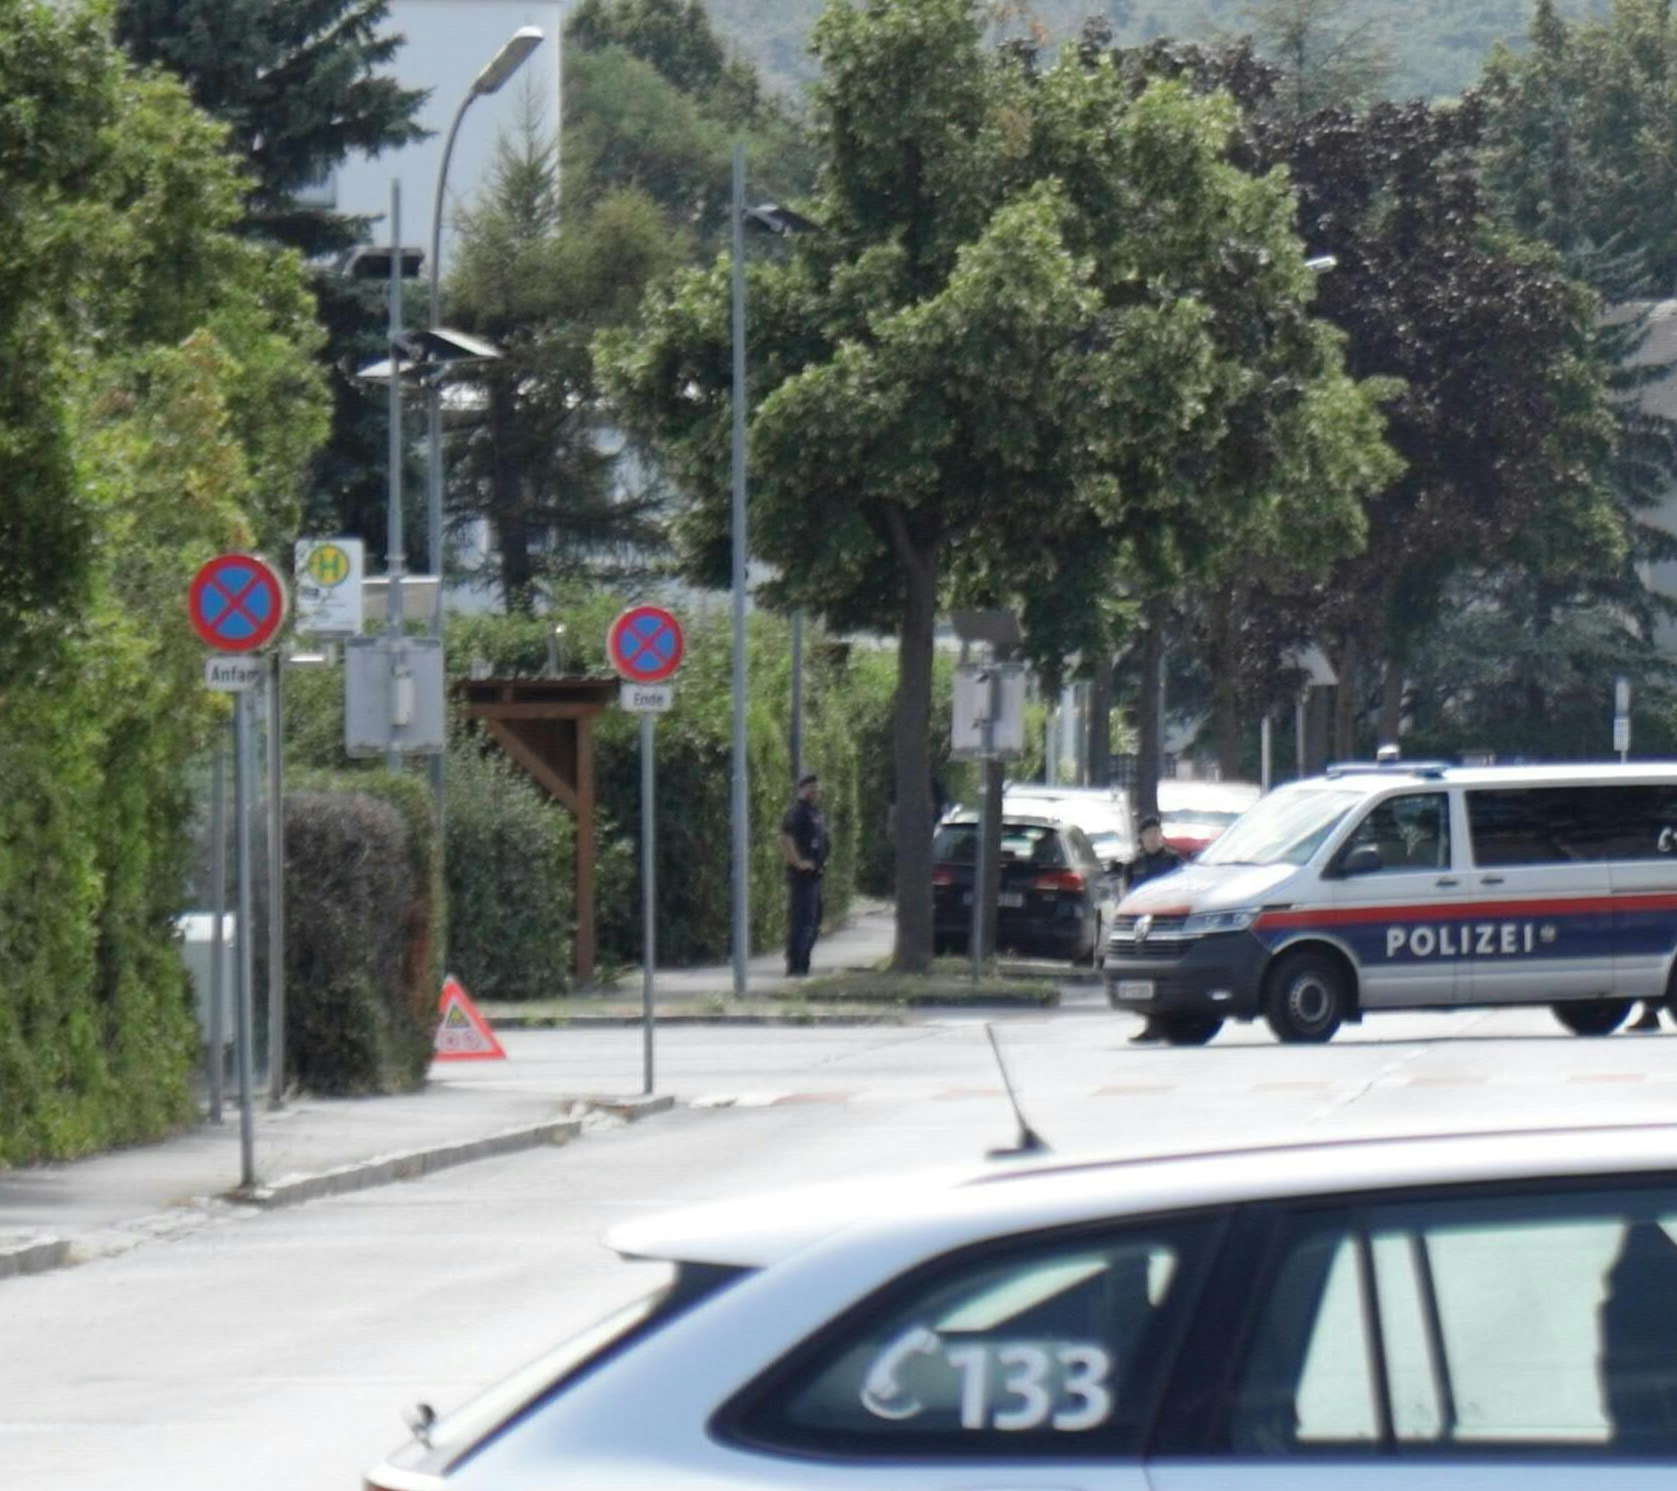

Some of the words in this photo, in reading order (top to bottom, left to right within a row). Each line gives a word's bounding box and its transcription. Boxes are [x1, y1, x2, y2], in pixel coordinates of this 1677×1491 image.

[633, 692, 664, 706] Ende
[1385, 921, 1535, 958] POLIZEI
[946, 1339, 1114, 1434] 133
